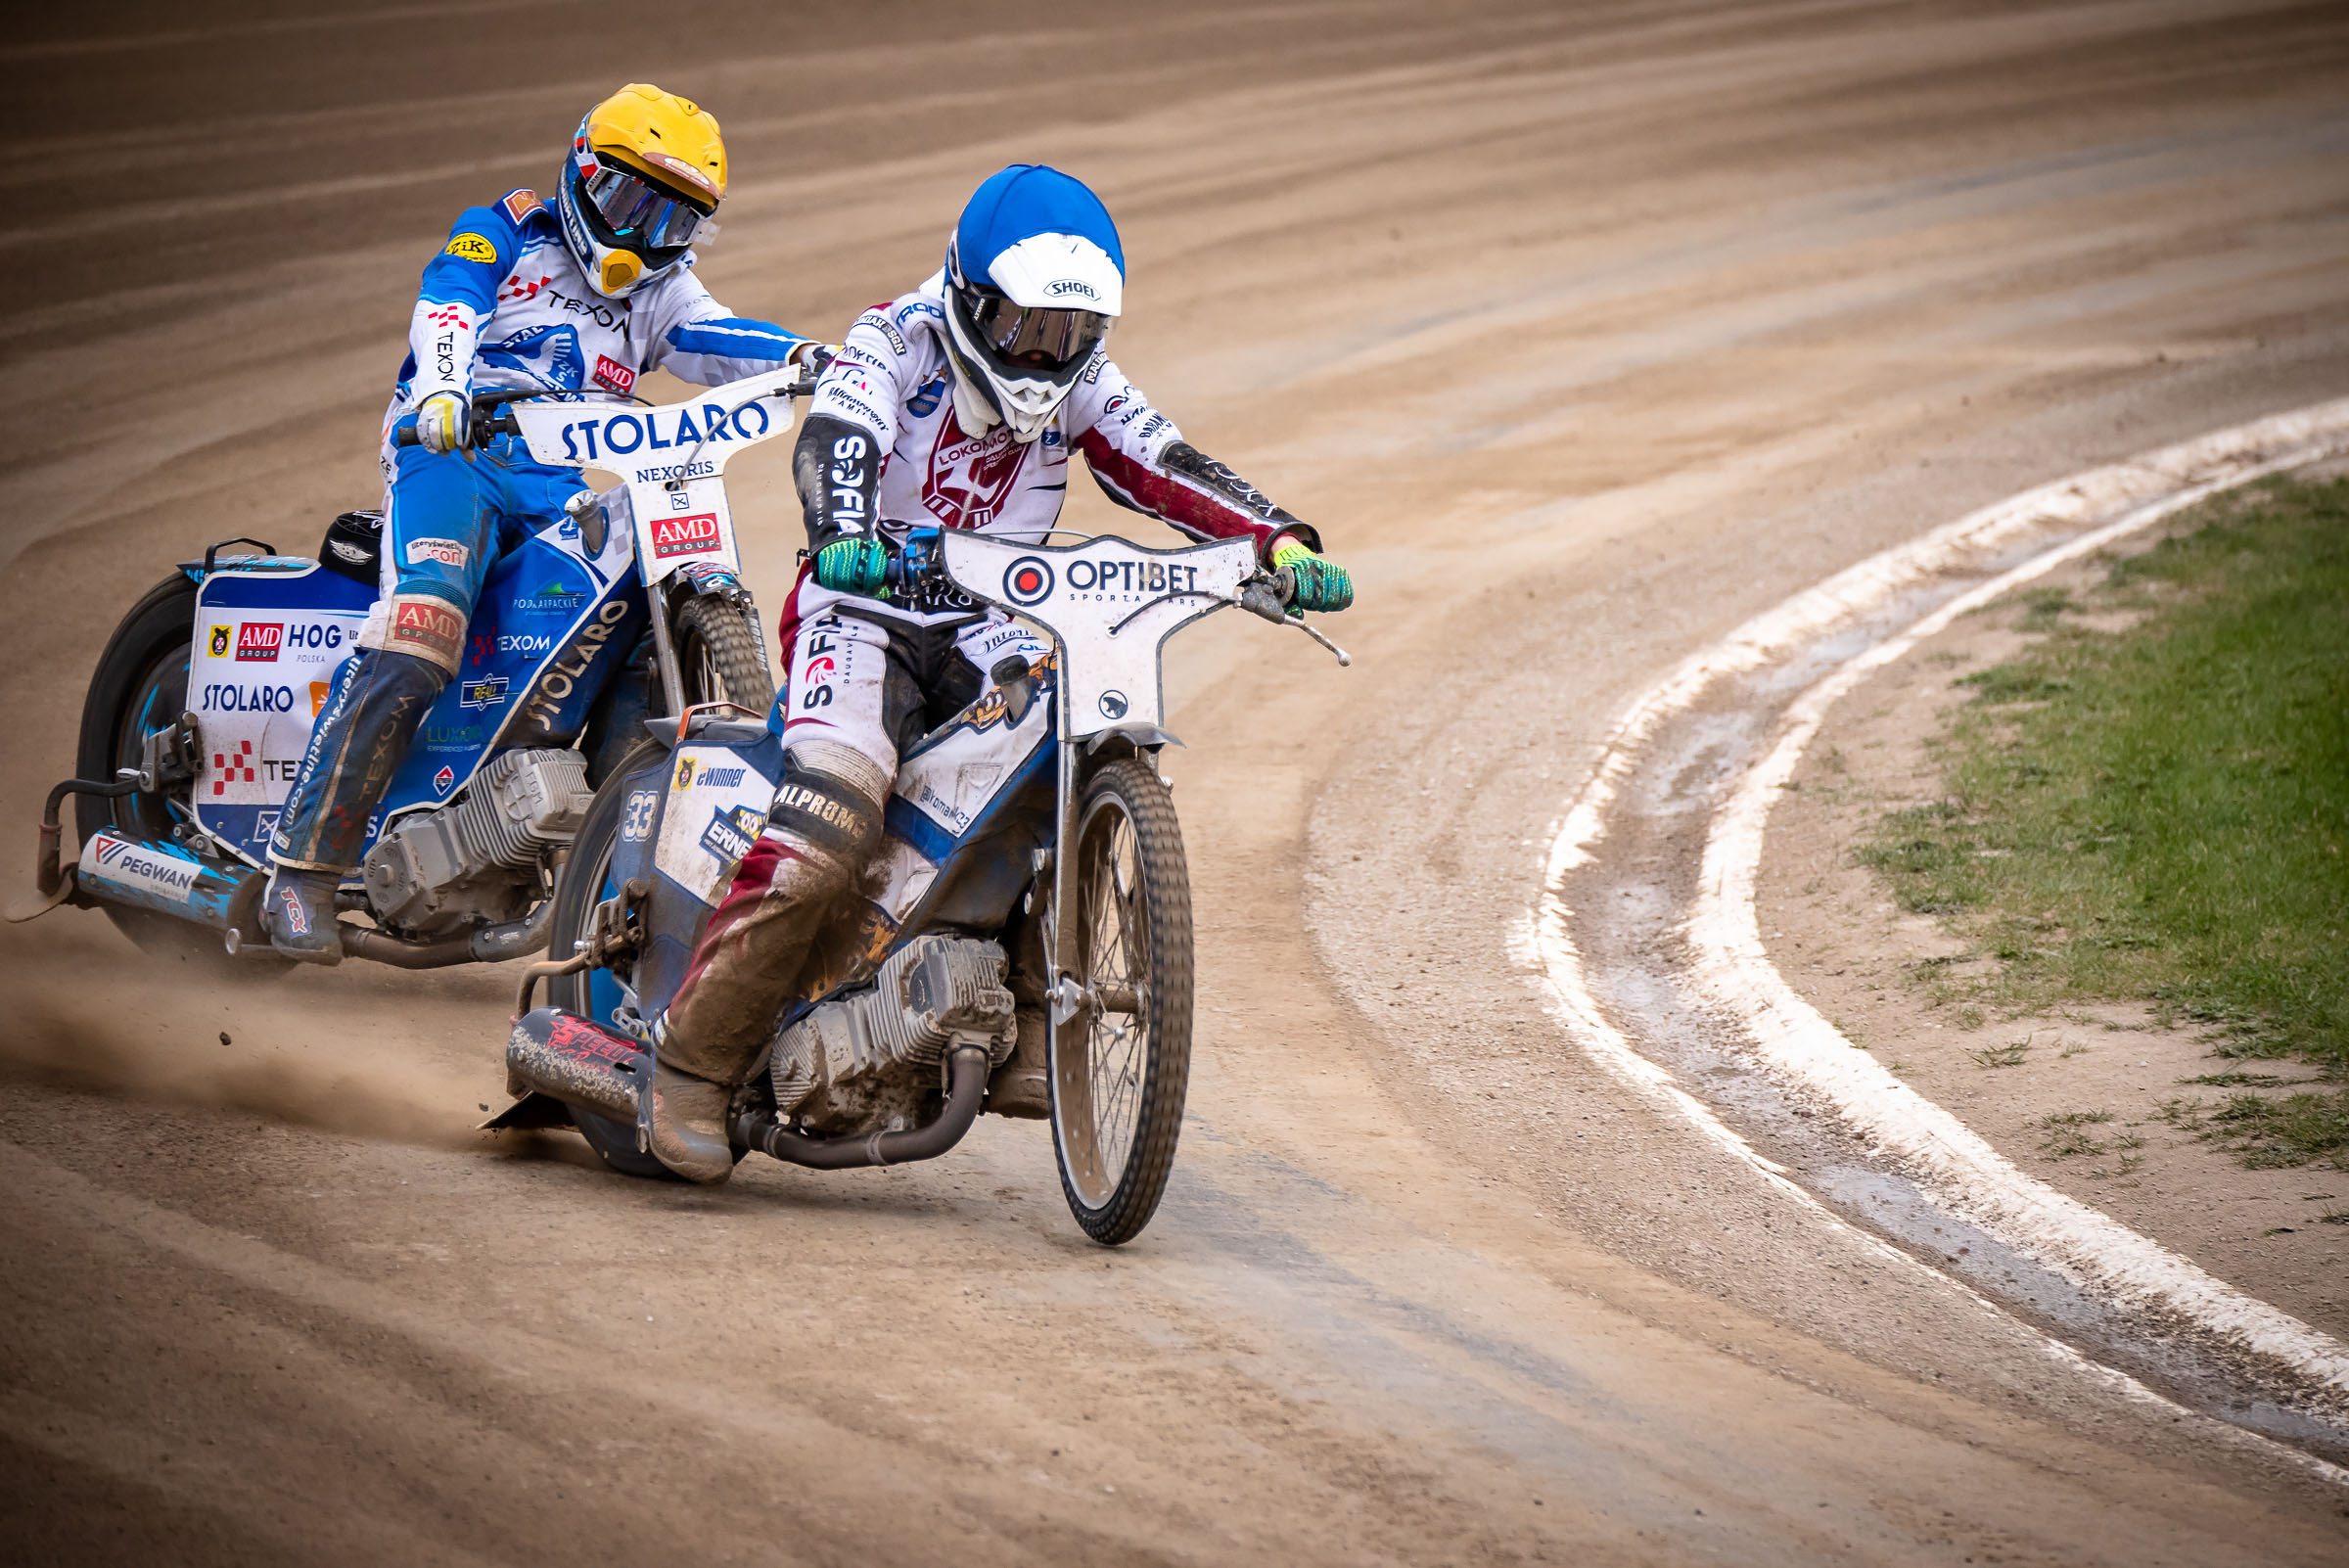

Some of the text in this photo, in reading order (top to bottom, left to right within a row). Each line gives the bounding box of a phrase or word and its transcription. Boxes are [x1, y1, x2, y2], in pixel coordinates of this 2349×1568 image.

[1051, 281, 1095, 299] SHOEI
[502, 325, 544, 348] STAL
[598, 360, 632, 387] AMD
[562, 401, 769, 460] STOLARO
[939, 429, 1014, 466] LOKOMOT
[636, 461, 714, 484] NEXORIS
[656, 517, 716, 544] AMD
[660, 539, 716, 555] GROUP
[1066, 560, 1198, 593] OPTIBET
[1070, 593, 1141, 603] SPORTA
[239, 626, 281, 647] AMD
[287, 624, 342, 649] HOG
[399, 606, 458, 640] AMD
[497, 635, 550, 652] TEXOM
[296, 654, 326, 663] POLSKA
[527, 600, 628, 731] STOLARO
[203, 684, 294, 713] STOLARO
[623, 790, 659, 842] 33
[708, 820, 752, 858] ERNE
[119, 855, 192, 890] PEGWAN
